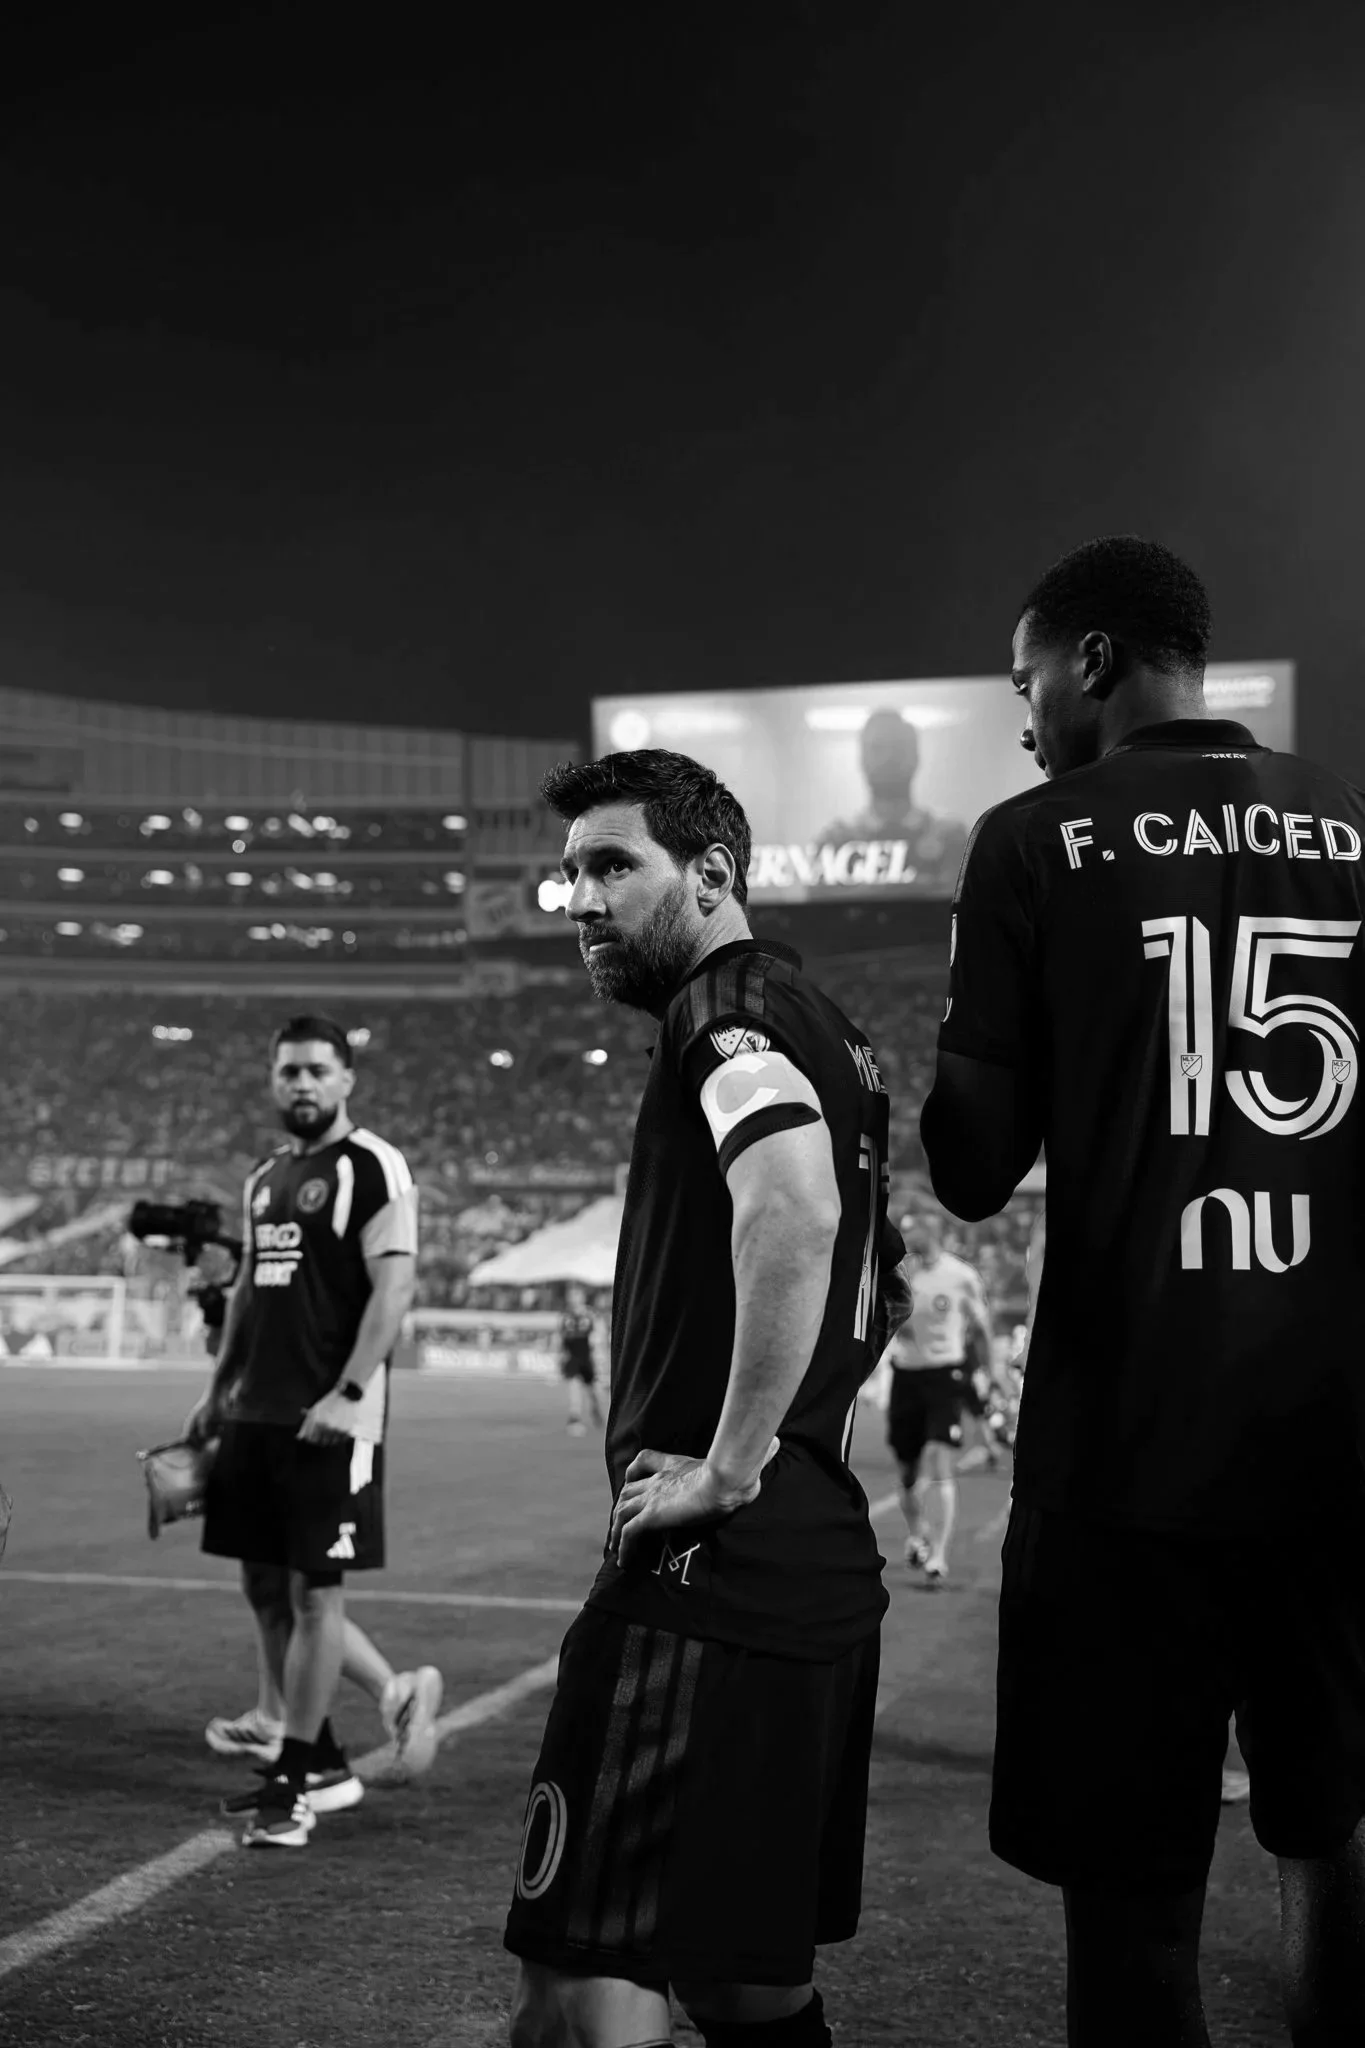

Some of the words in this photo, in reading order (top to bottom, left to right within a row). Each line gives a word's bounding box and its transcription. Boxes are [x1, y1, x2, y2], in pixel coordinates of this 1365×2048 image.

[1059, 817, 1116, 870] F.
[1133, 803, 1362, 862] CAICED
[1141, 915, 1362, 1141] 15
[704, 1053, 780, 1132] C
[1180, 1187, 1311, 1274] nu
